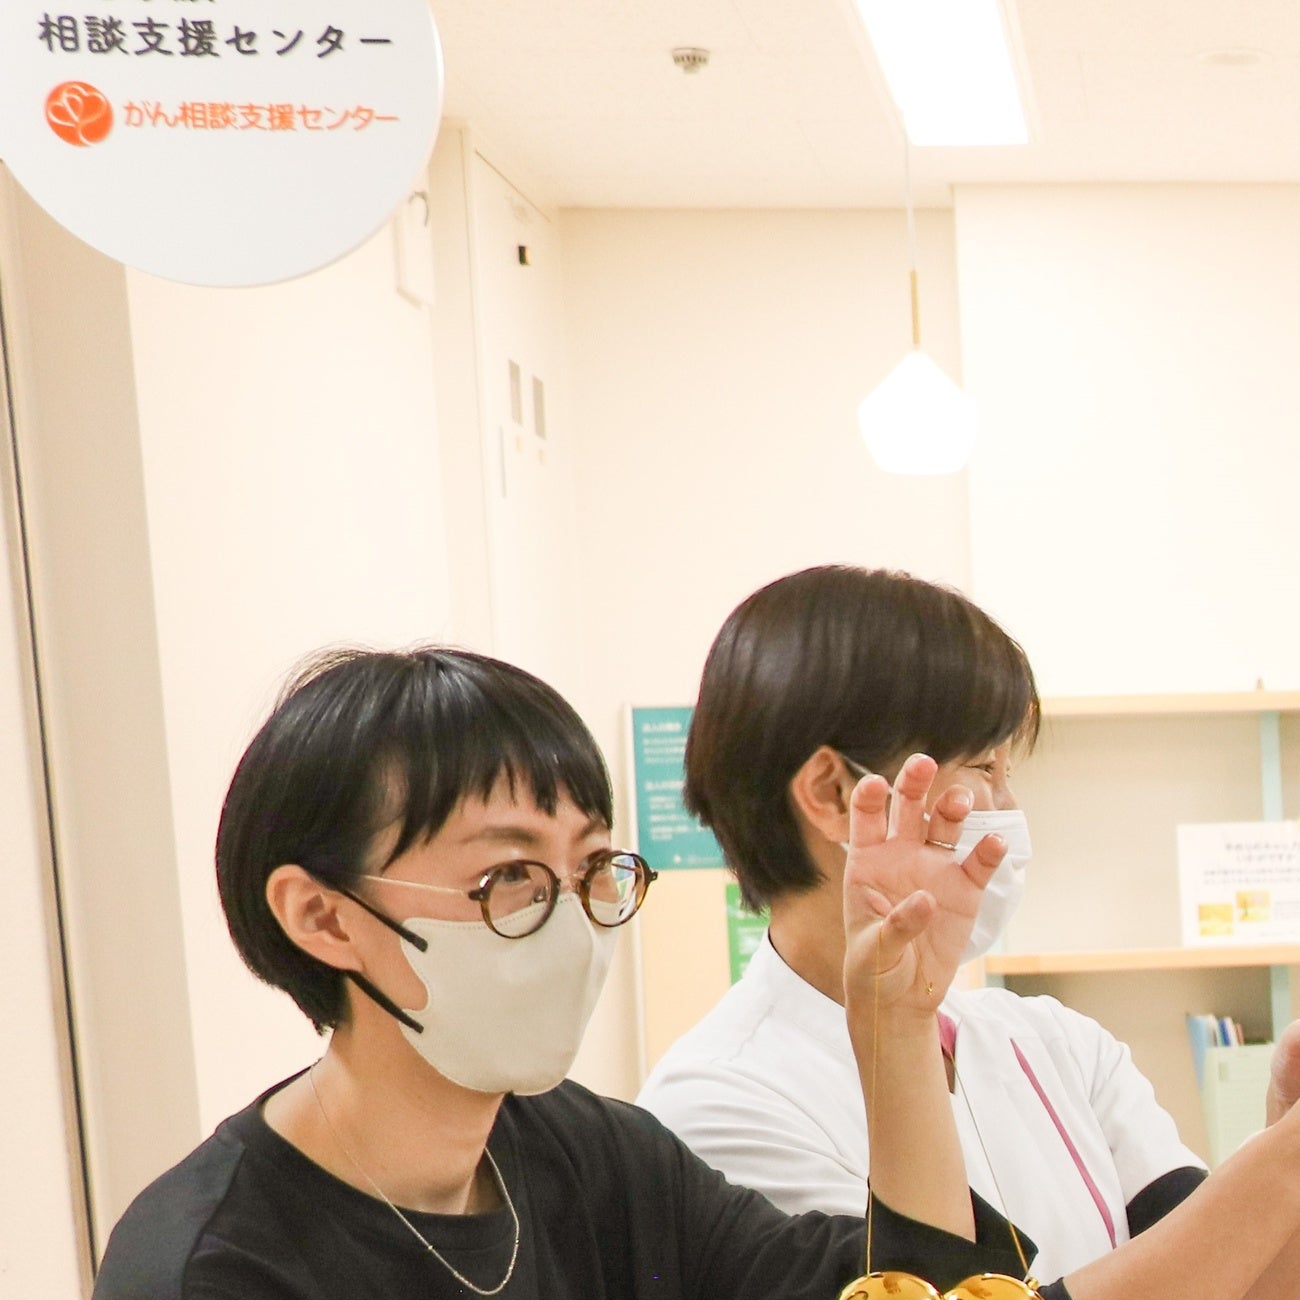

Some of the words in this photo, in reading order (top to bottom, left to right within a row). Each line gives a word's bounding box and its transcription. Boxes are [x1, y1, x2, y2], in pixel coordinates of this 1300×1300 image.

[38, 13, 393, 58] 相談支援センター
[123, 100, 399, 132] がん相談支援センター
